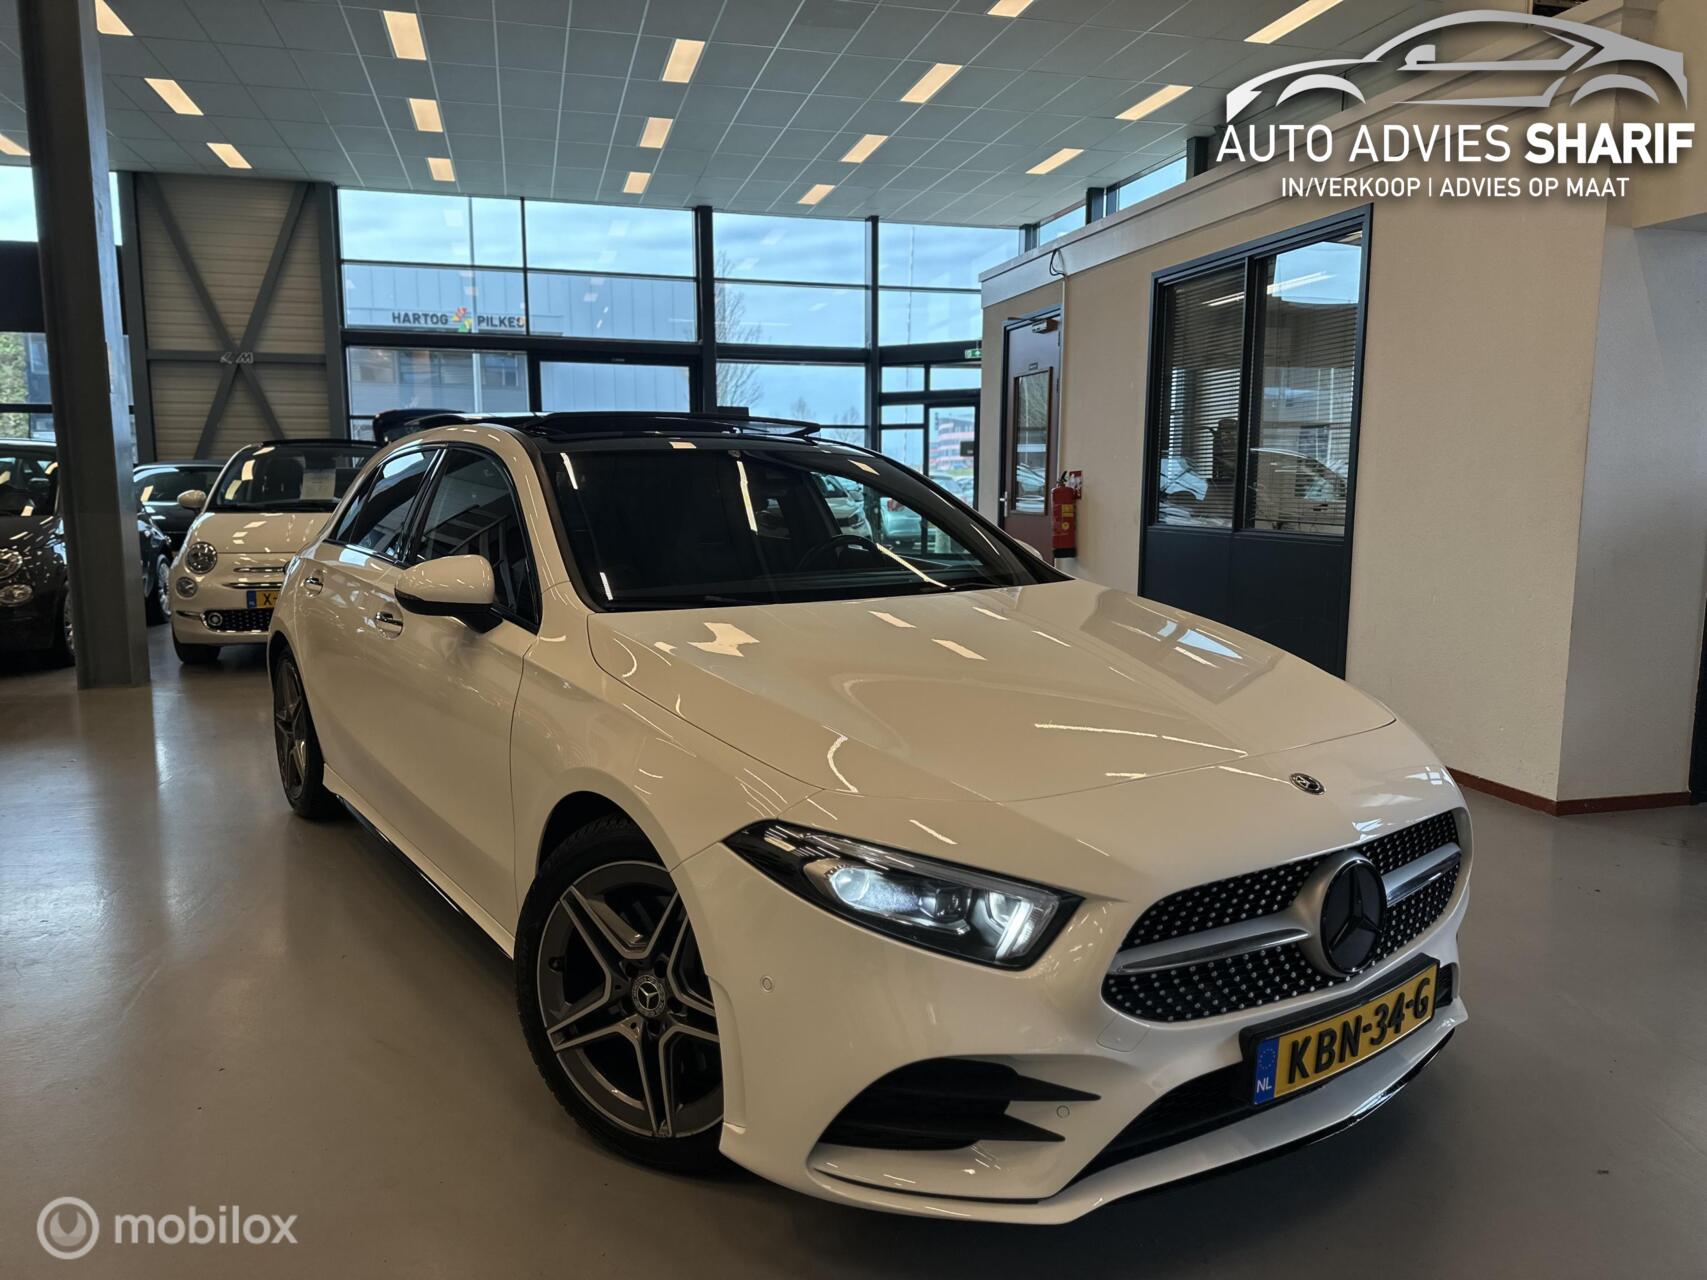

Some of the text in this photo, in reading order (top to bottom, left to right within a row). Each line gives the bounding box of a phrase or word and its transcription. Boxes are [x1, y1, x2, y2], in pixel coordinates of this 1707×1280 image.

[391, 311, 526, 329] HARTOG PILKES
[1287, 977, 1431, 1085] KBN-34-G
[1256, 1079, 1273, 1094] NL
